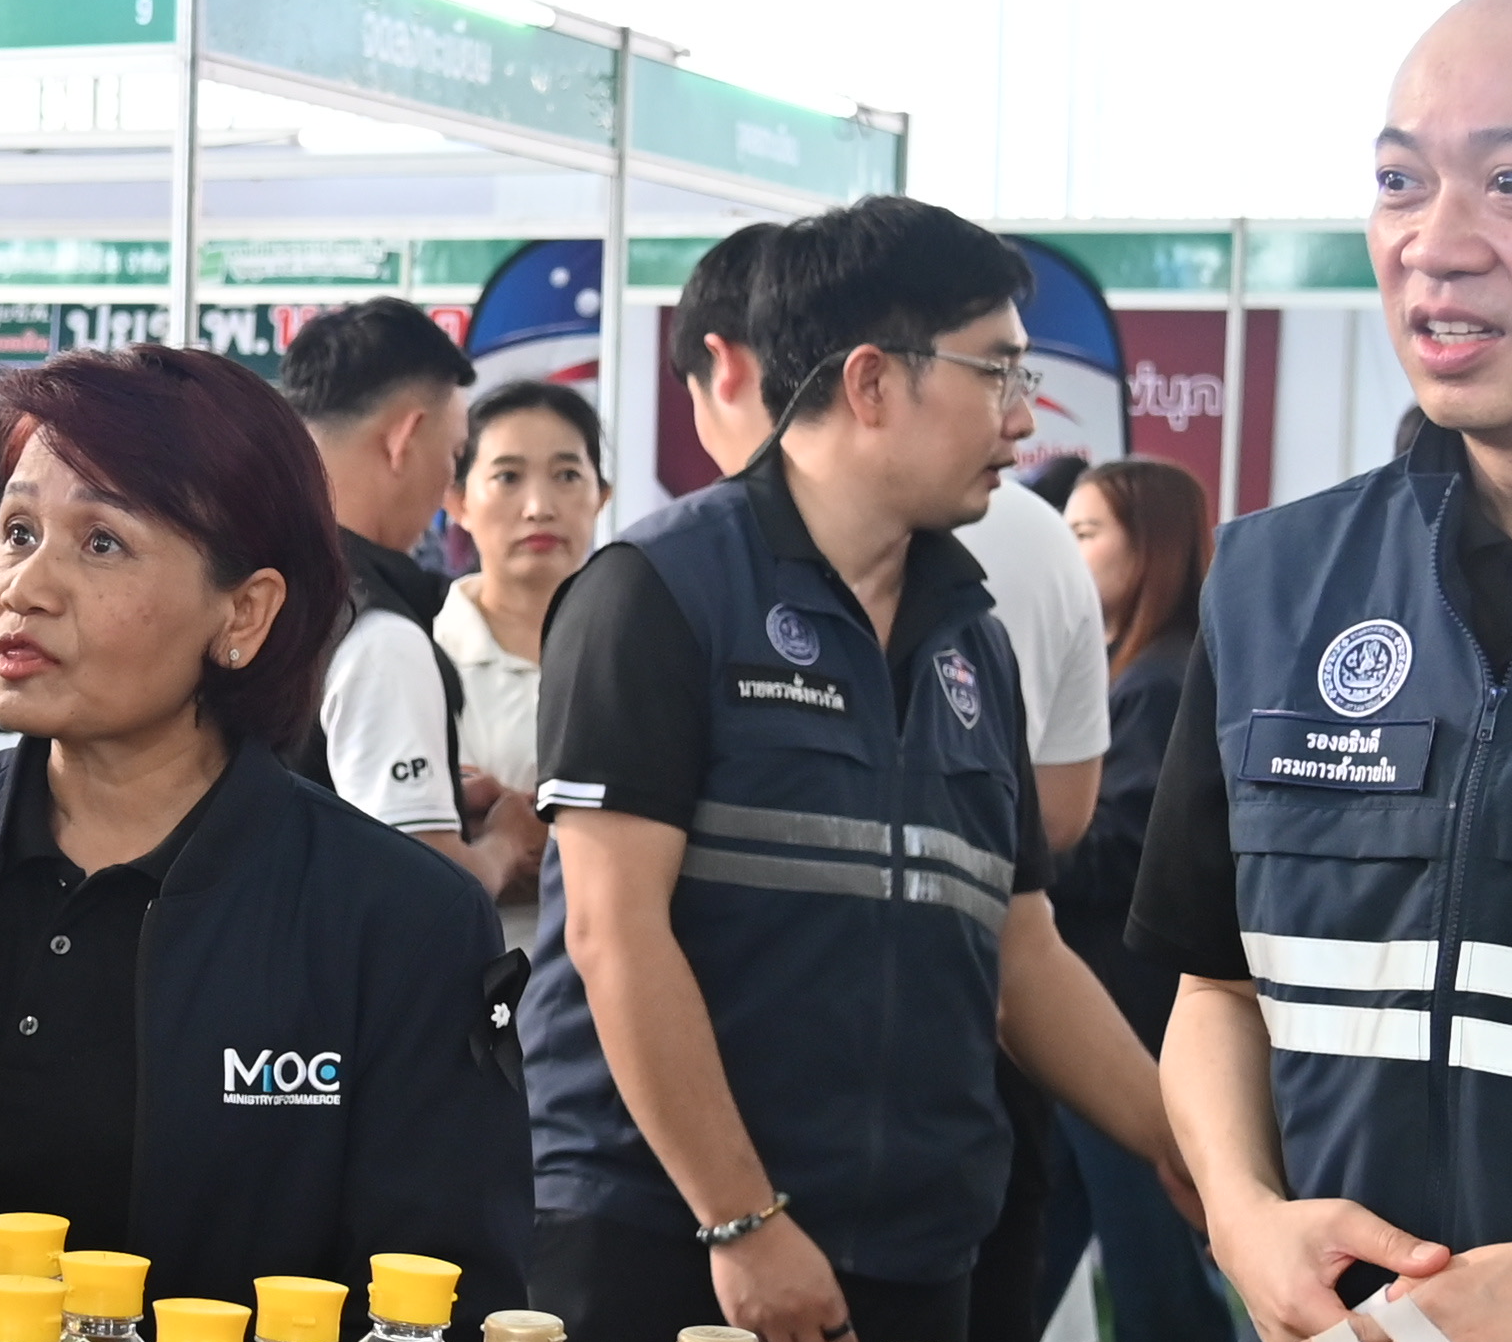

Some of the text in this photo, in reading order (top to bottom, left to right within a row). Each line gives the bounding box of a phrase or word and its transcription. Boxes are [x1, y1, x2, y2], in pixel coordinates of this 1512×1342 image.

[1306, 727, 1382, 754] รองอธิบดี
[391, 757, 435, 782] CP
[1270, 755, 1397, 783] กรมการค้าภายใน
[223, 1047, 342, 1093] MOC
[223, 1092, 273, 1106] MINISTRY
